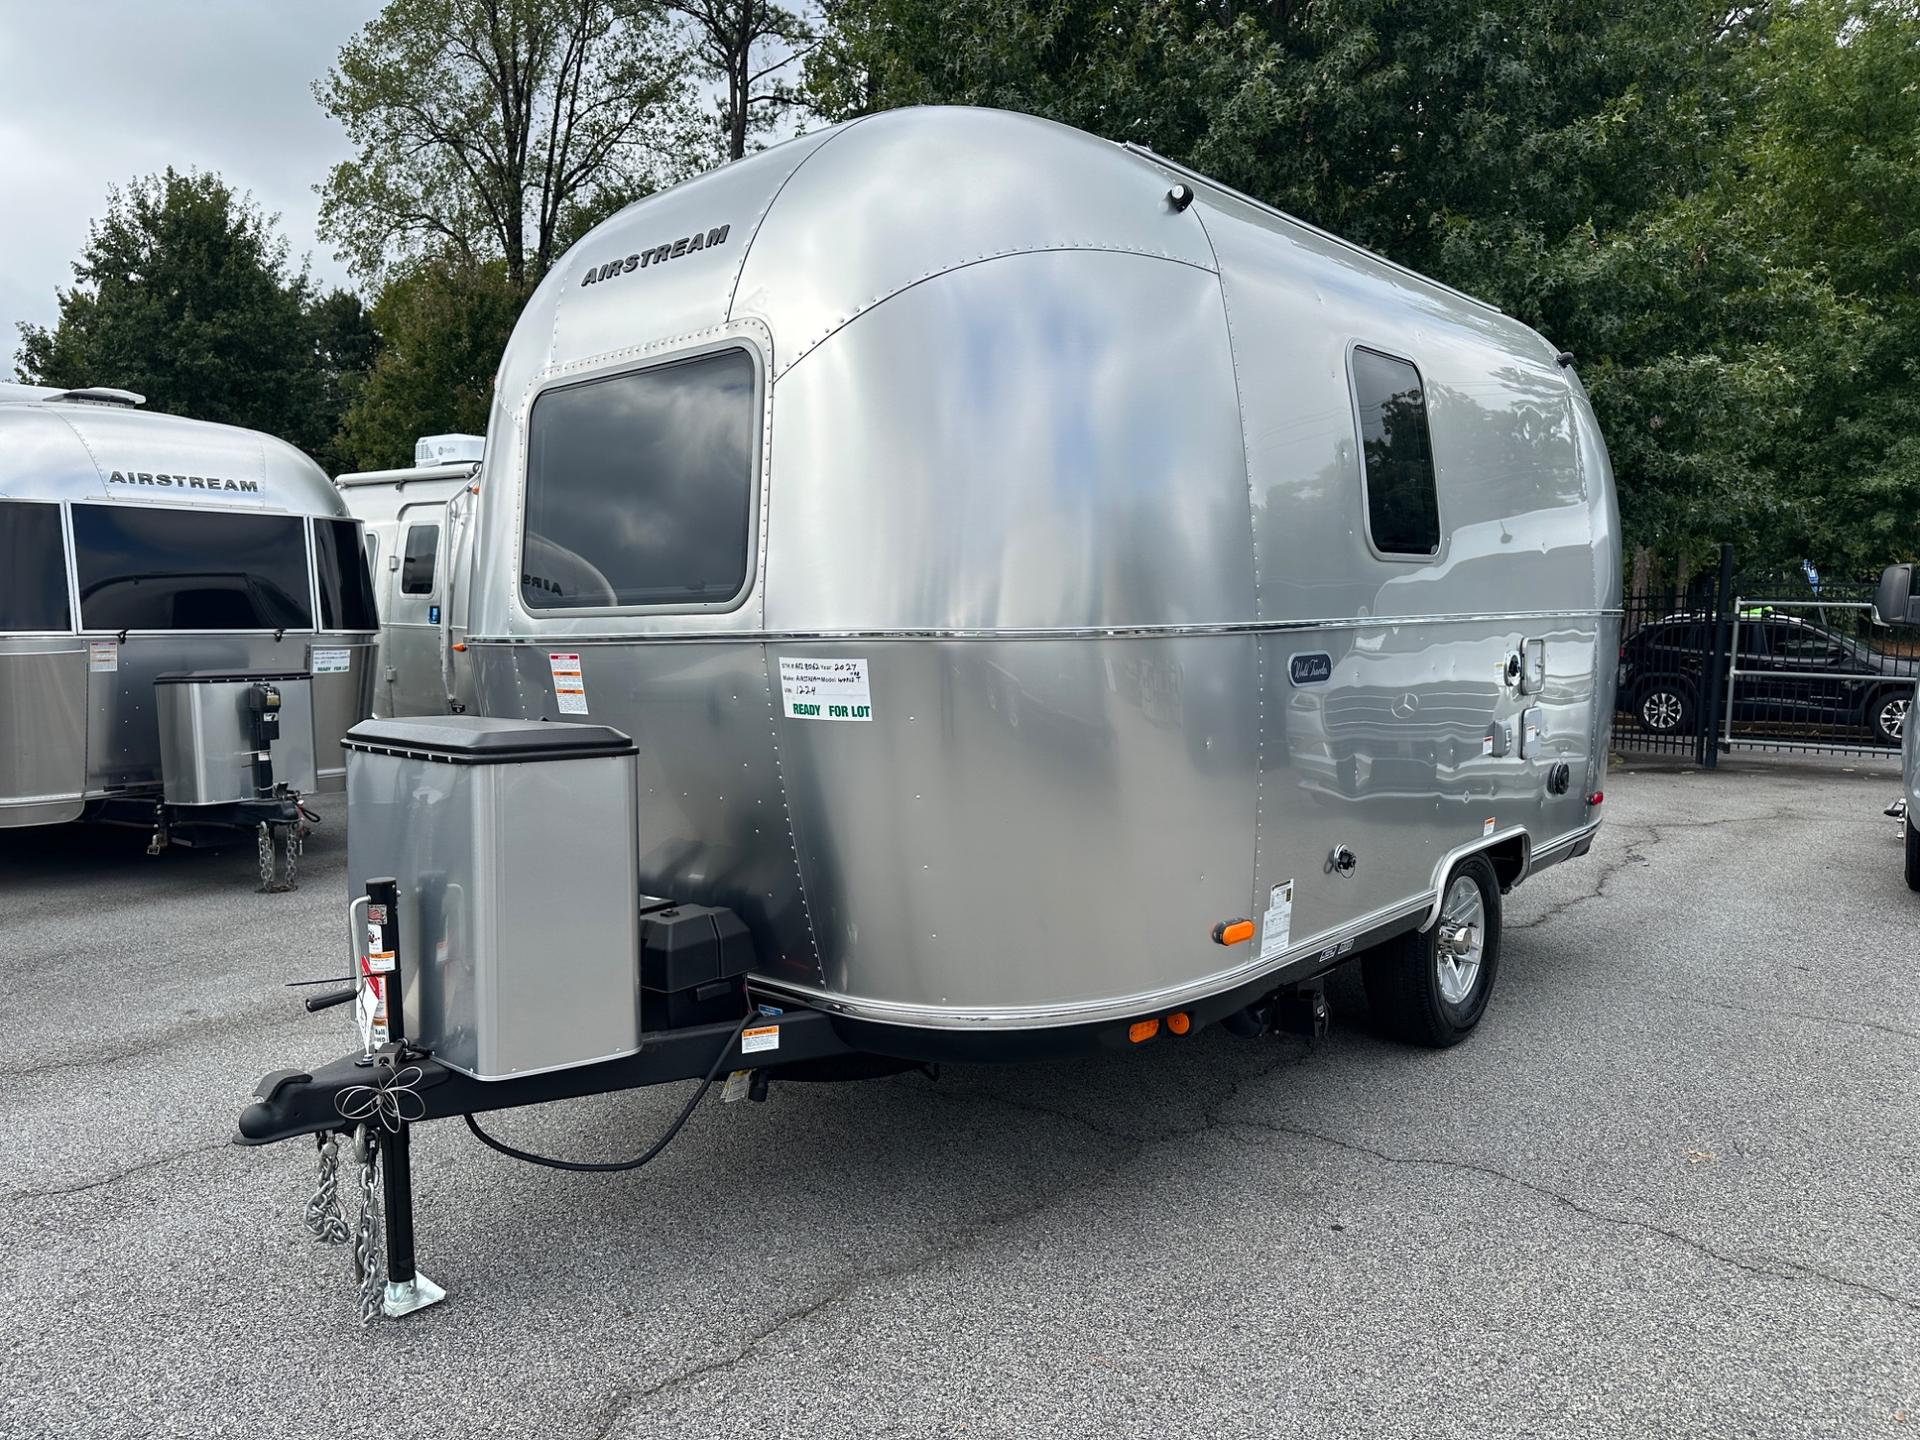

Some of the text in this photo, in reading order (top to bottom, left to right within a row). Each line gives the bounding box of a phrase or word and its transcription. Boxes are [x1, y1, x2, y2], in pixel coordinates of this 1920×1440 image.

[581, 224, 731, 287] AIRSTREAM
[109, 470, 259, 492] AIRSTREAM
[793, 703, 870, 718] READY FOR LOT
